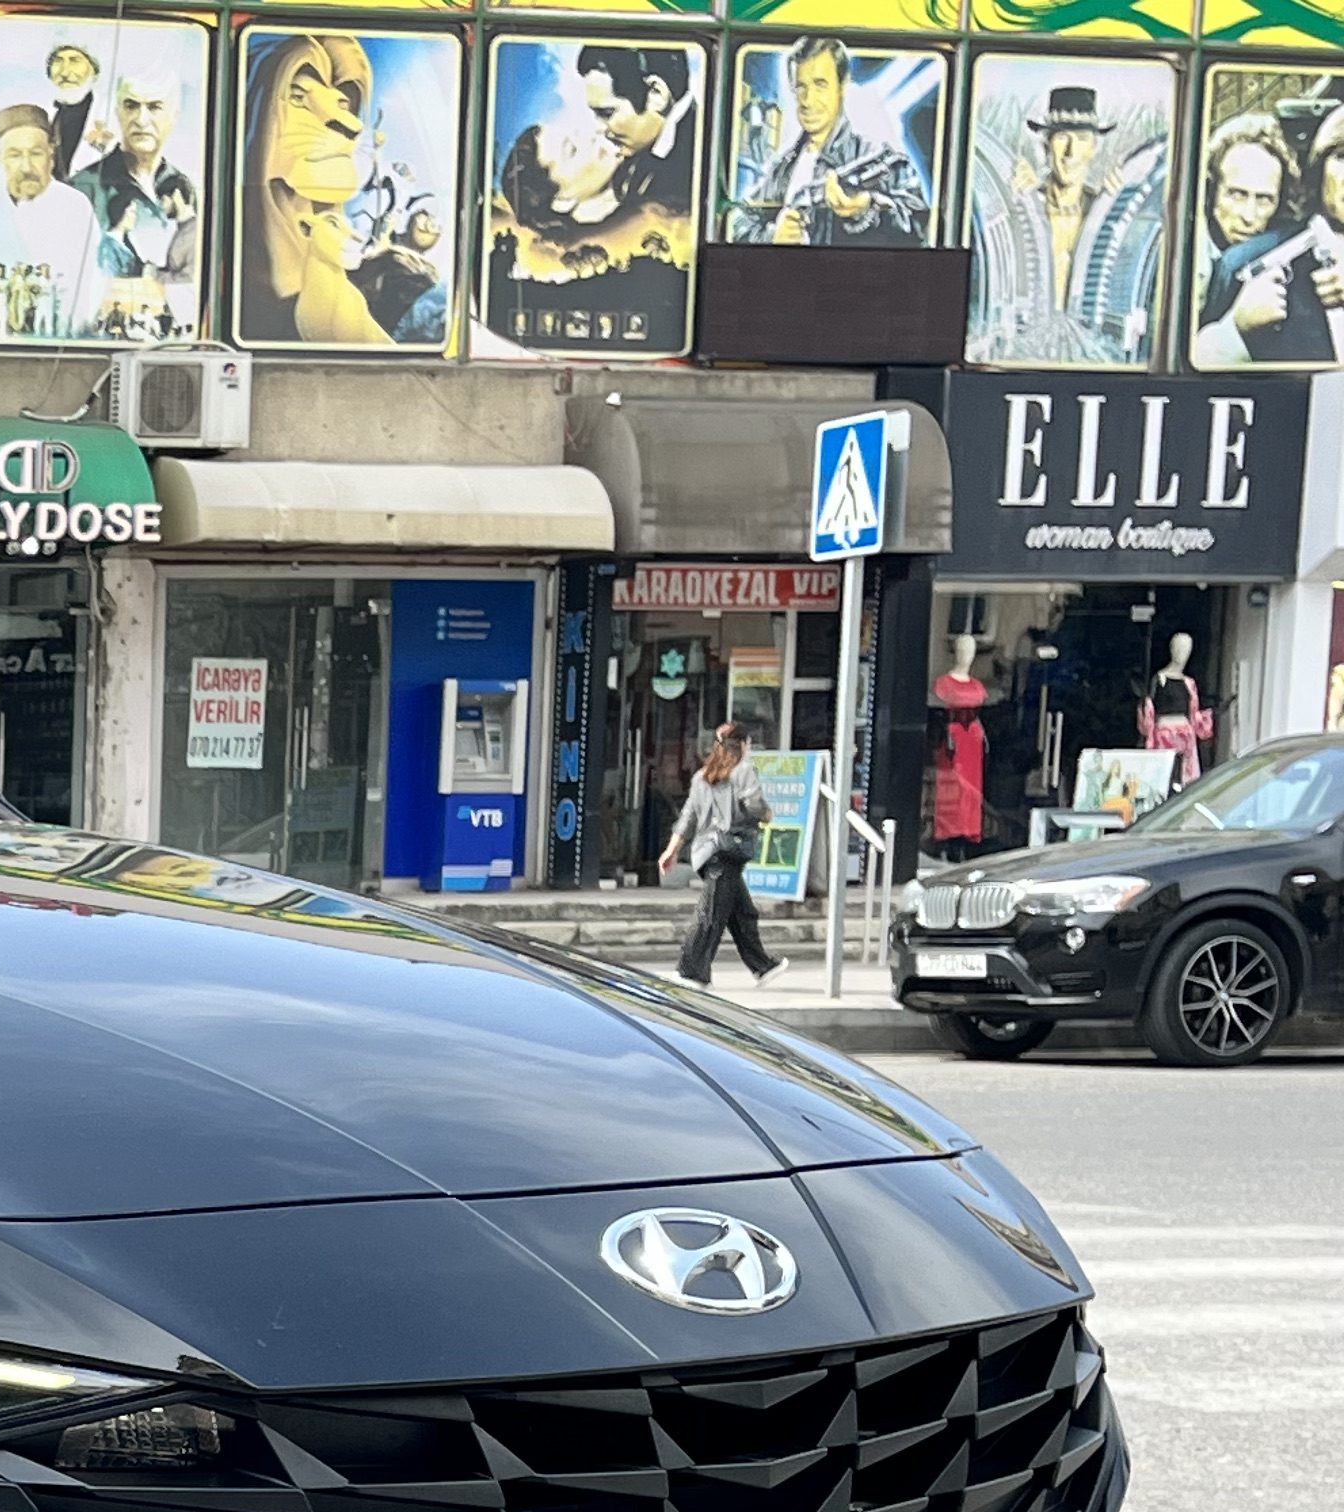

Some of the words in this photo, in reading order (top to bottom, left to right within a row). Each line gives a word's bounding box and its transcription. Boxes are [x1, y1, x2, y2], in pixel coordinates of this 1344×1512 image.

[998, 393, 1255, 508] ELLE
[35, 501, 163, 543] DOSE
[1025, 523, 1114, 550] woman
[1116, 516, 1215, 557] boutique
[792, 572, 840, 596] VIP
[196, 662, 262, 692] İCARƏYƏ
[193, 695, 262, 725] VERİLİR
[555, 610, 589, 842] KINO
[470, 808, 503, 828] VTB
